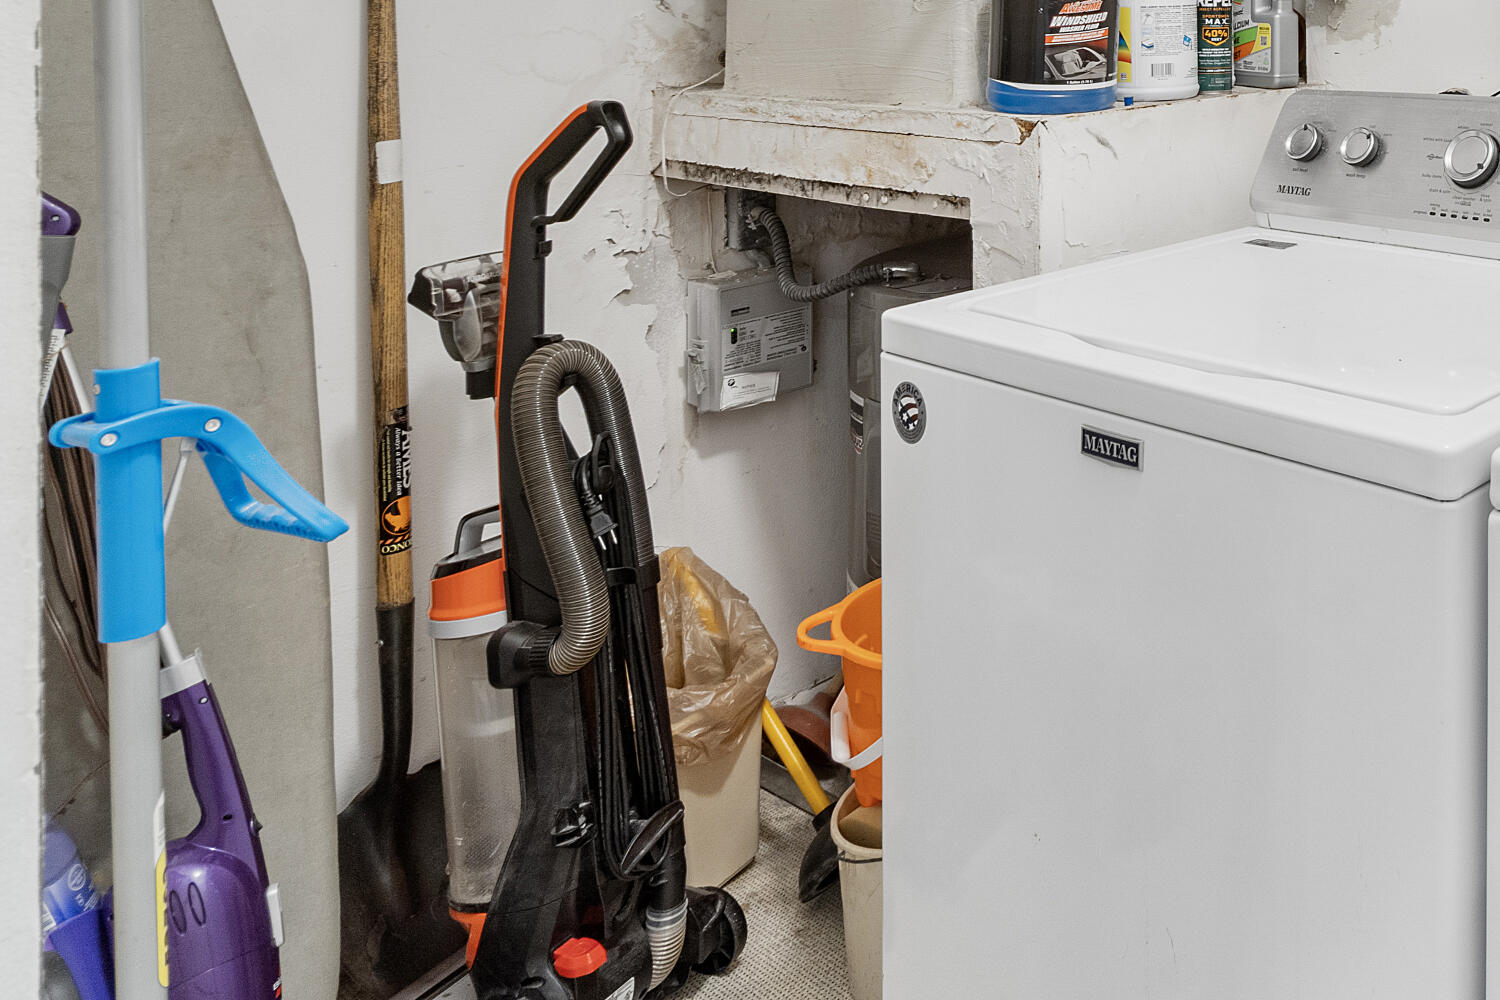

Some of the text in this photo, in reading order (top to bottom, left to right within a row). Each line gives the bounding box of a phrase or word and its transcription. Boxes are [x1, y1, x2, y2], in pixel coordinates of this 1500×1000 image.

[1048, 11, 1109, 29] WINDSHIELD
[1204, 29, 1228, 39] 40%
[1276, 184, 1312, 197] MAYTAG
[893, 383, 922, 407] AMERICA
[1084, 433, 1138, 463] MAYTAG
